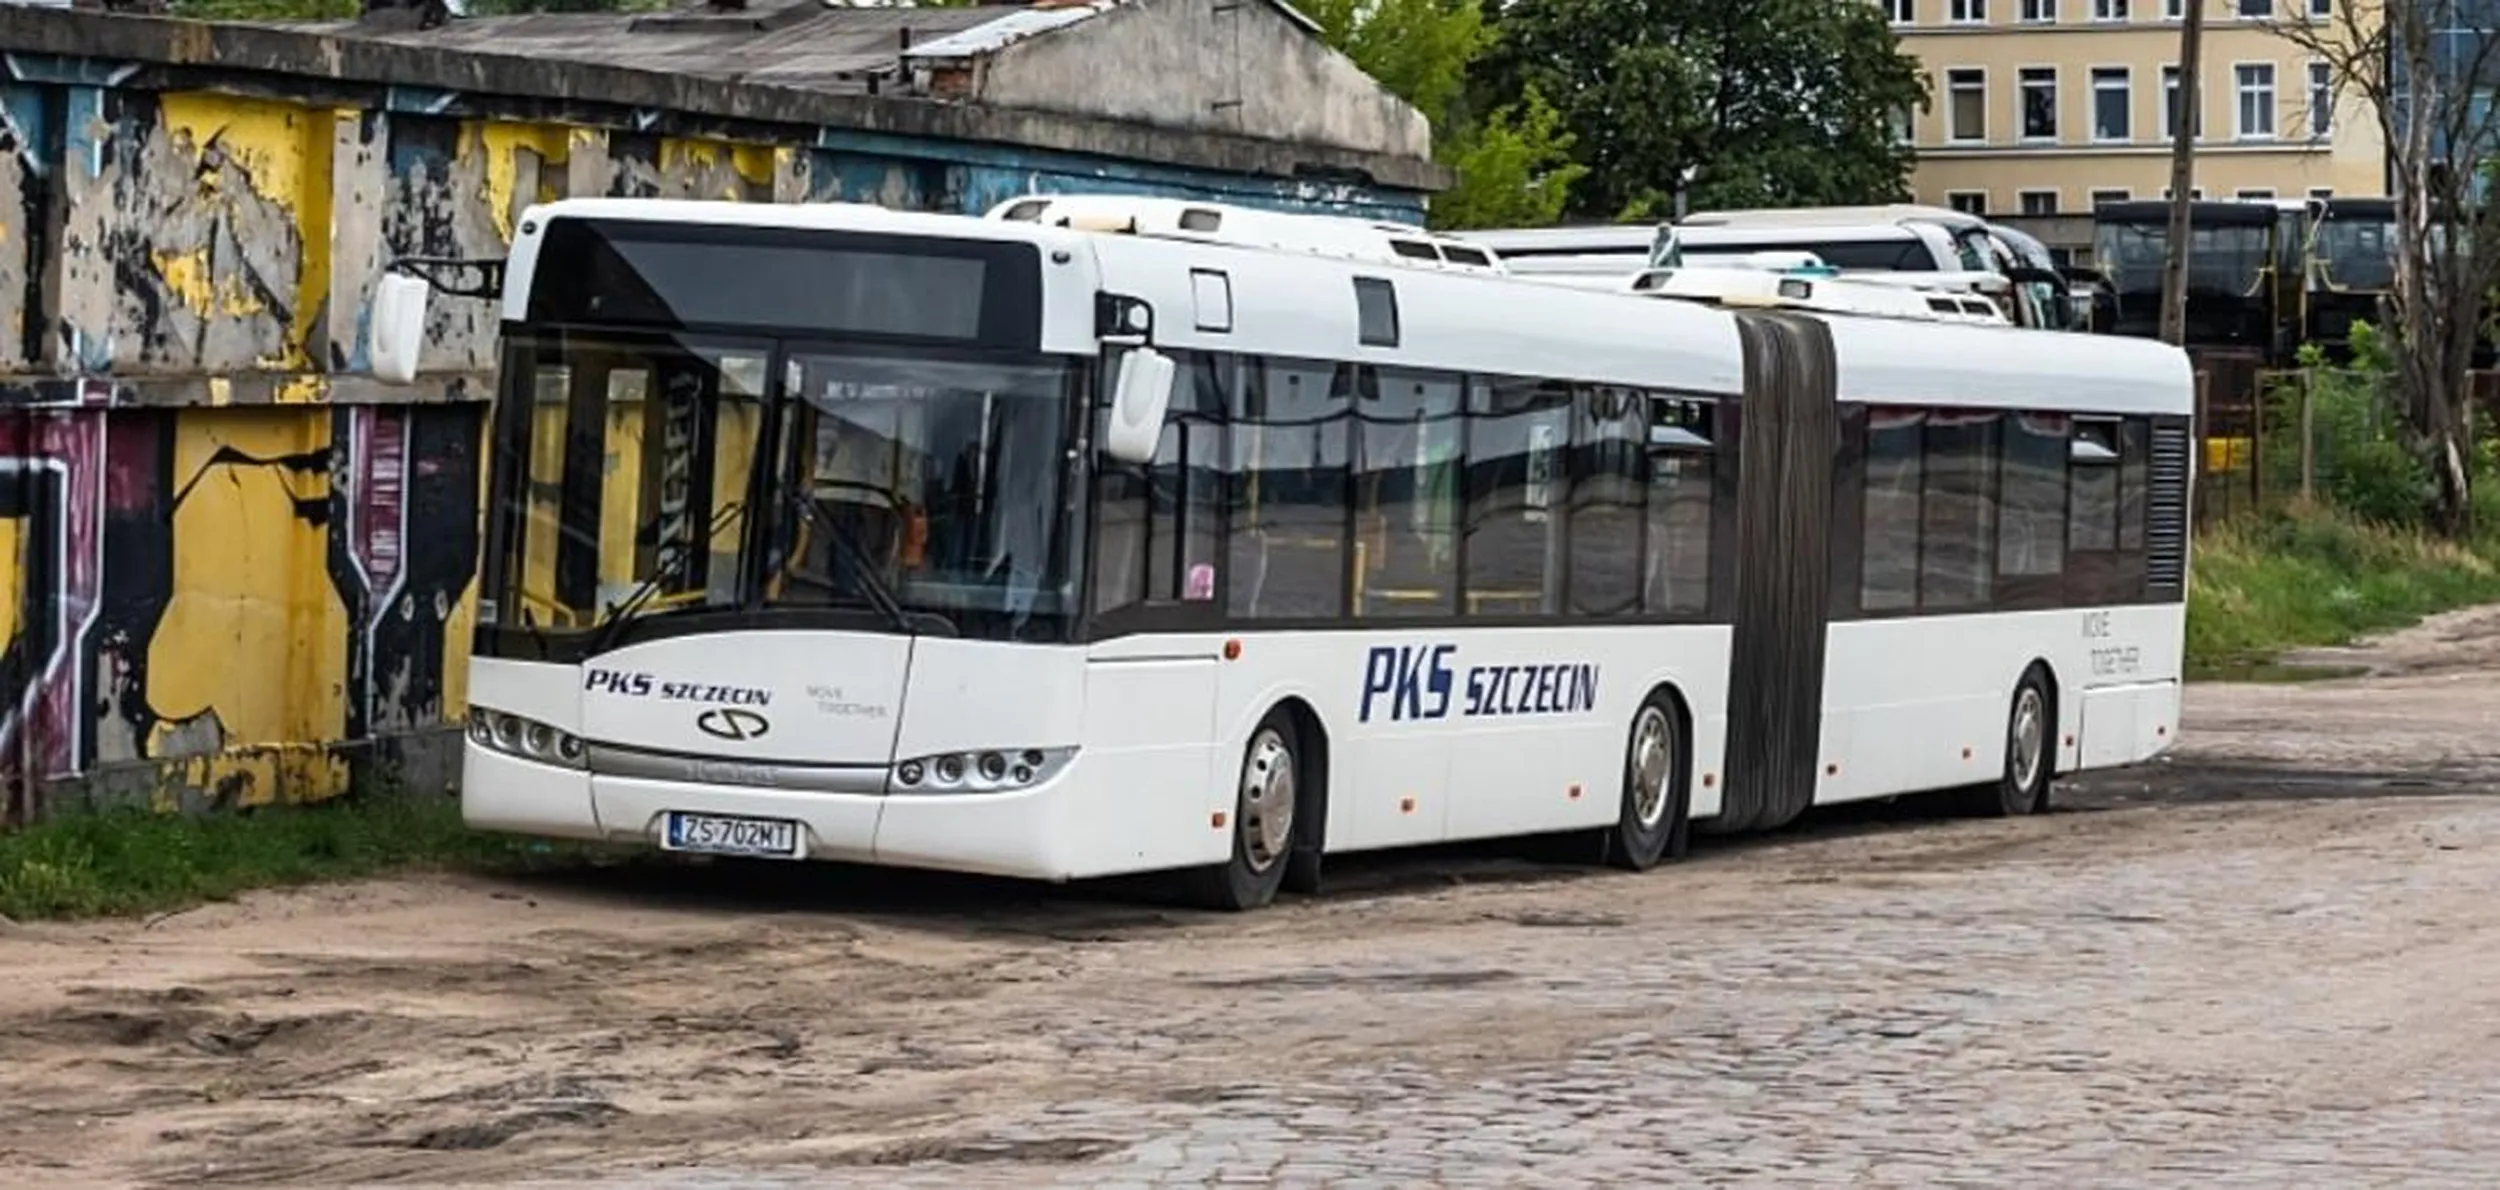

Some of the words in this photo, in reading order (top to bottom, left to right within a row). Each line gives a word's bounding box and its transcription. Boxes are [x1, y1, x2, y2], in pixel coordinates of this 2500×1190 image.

[585, 669, 654, 696] PKS
[661, 682, 772, 705] SZCZECIN
[1358, 644, 1458, 723] PKS
[1463, 663, 1601, 716] SZCZECIN
[685, 818, 713, 843] ZS
